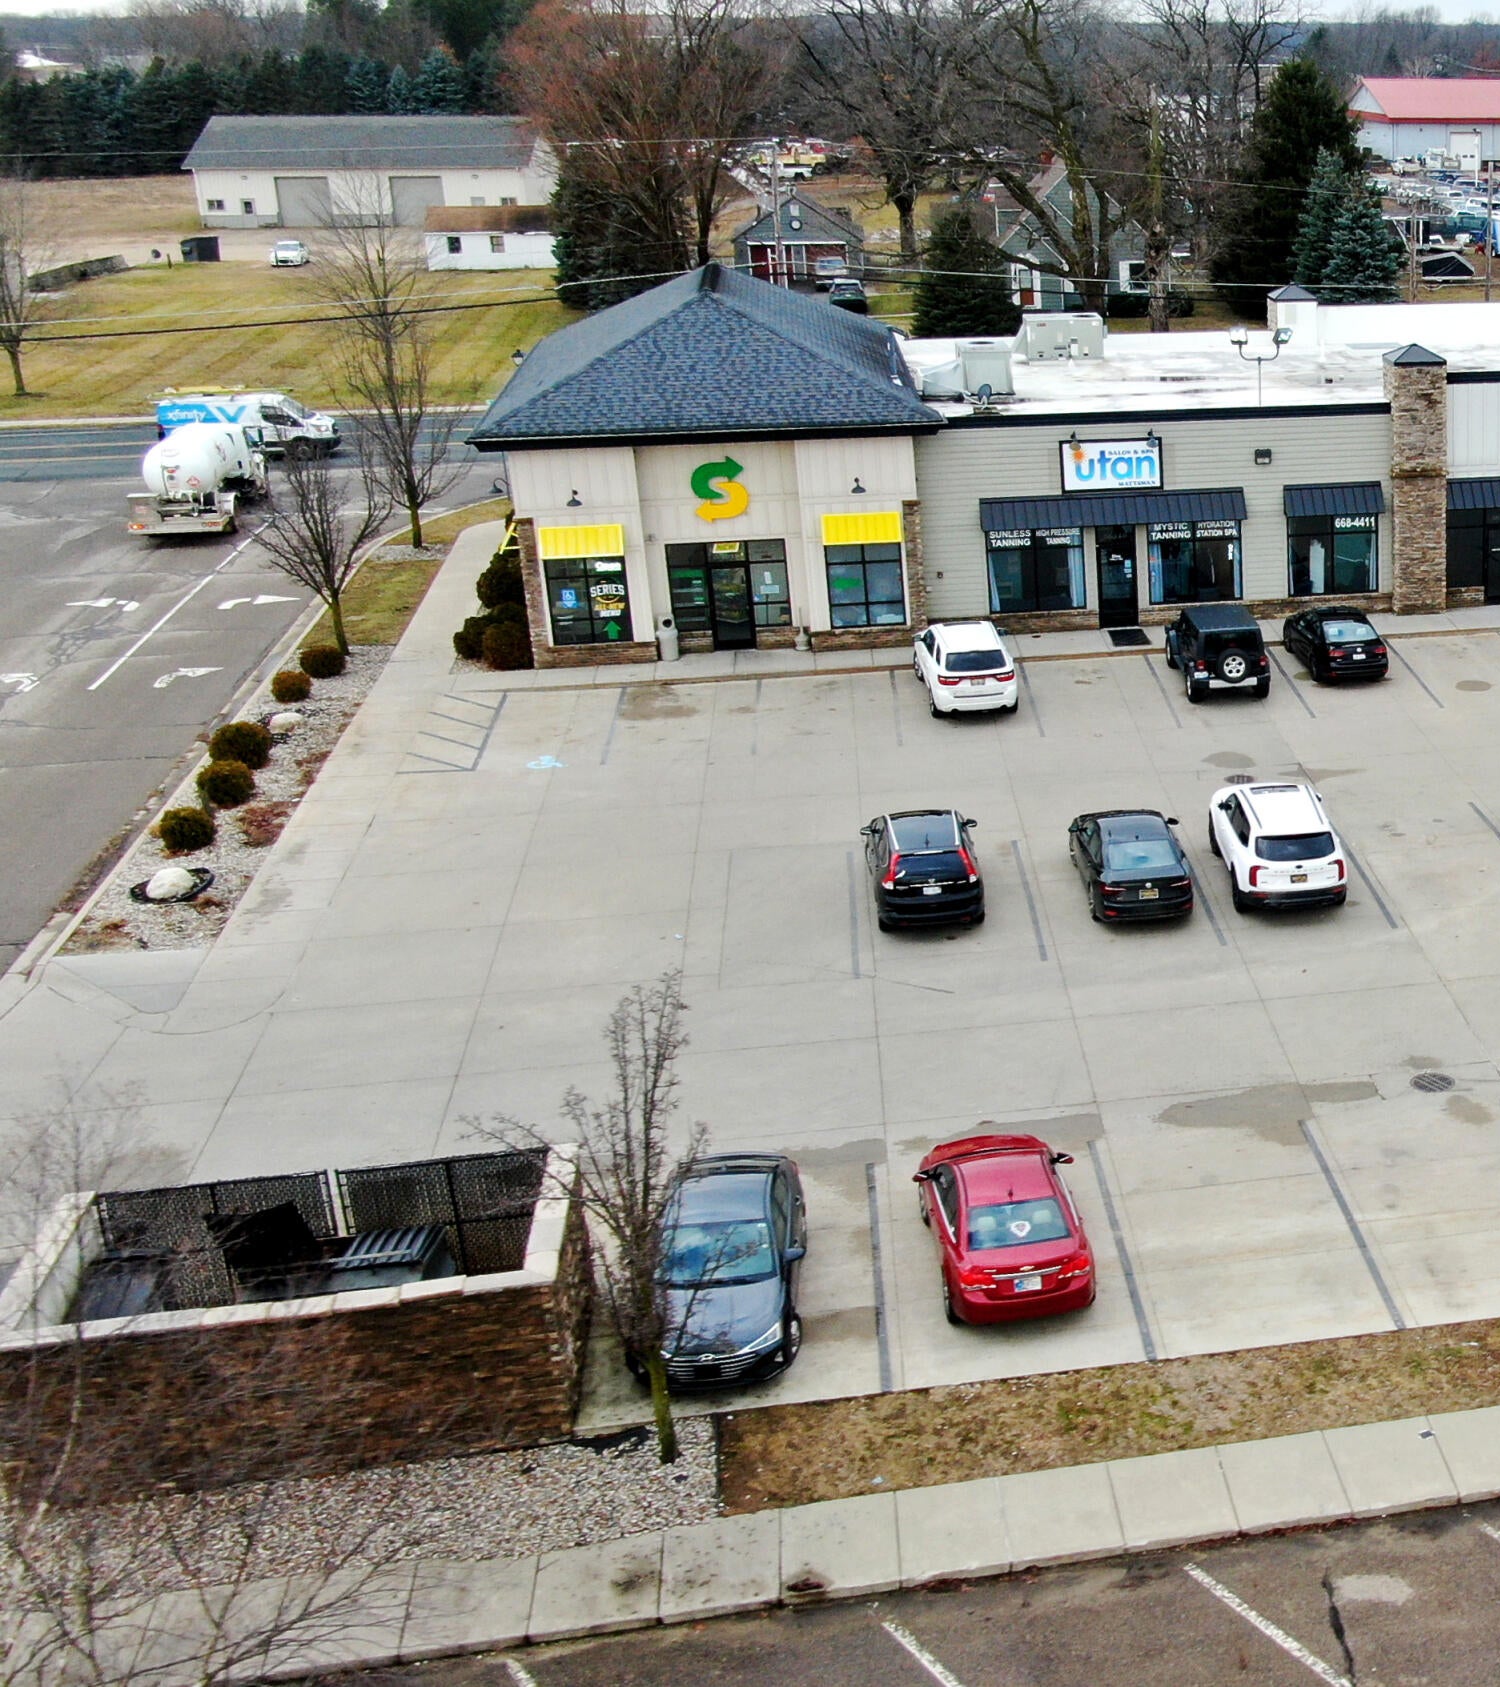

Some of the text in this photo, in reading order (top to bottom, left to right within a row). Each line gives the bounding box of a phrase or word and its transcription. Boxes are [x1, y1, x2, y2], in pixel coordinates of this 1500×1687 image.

[168, 409, 206, 423] xfinity
[1153, 522, 1188, 531] MYSTIC
[1198, 520, 1235, 529] HYDRATION
[1335, 516, 1375, 528] 668-4411
[989, 529, 1031, 539] SUNLESS
[1151, 531, 1191, 540] TANNING
[1196, 528, 1238, 538] STATION SPA
[990, 538, 1031, 547] TANNING
[1046, 536, 1071, 545] TANNING
[590, 584, 625, 597] SERIES
